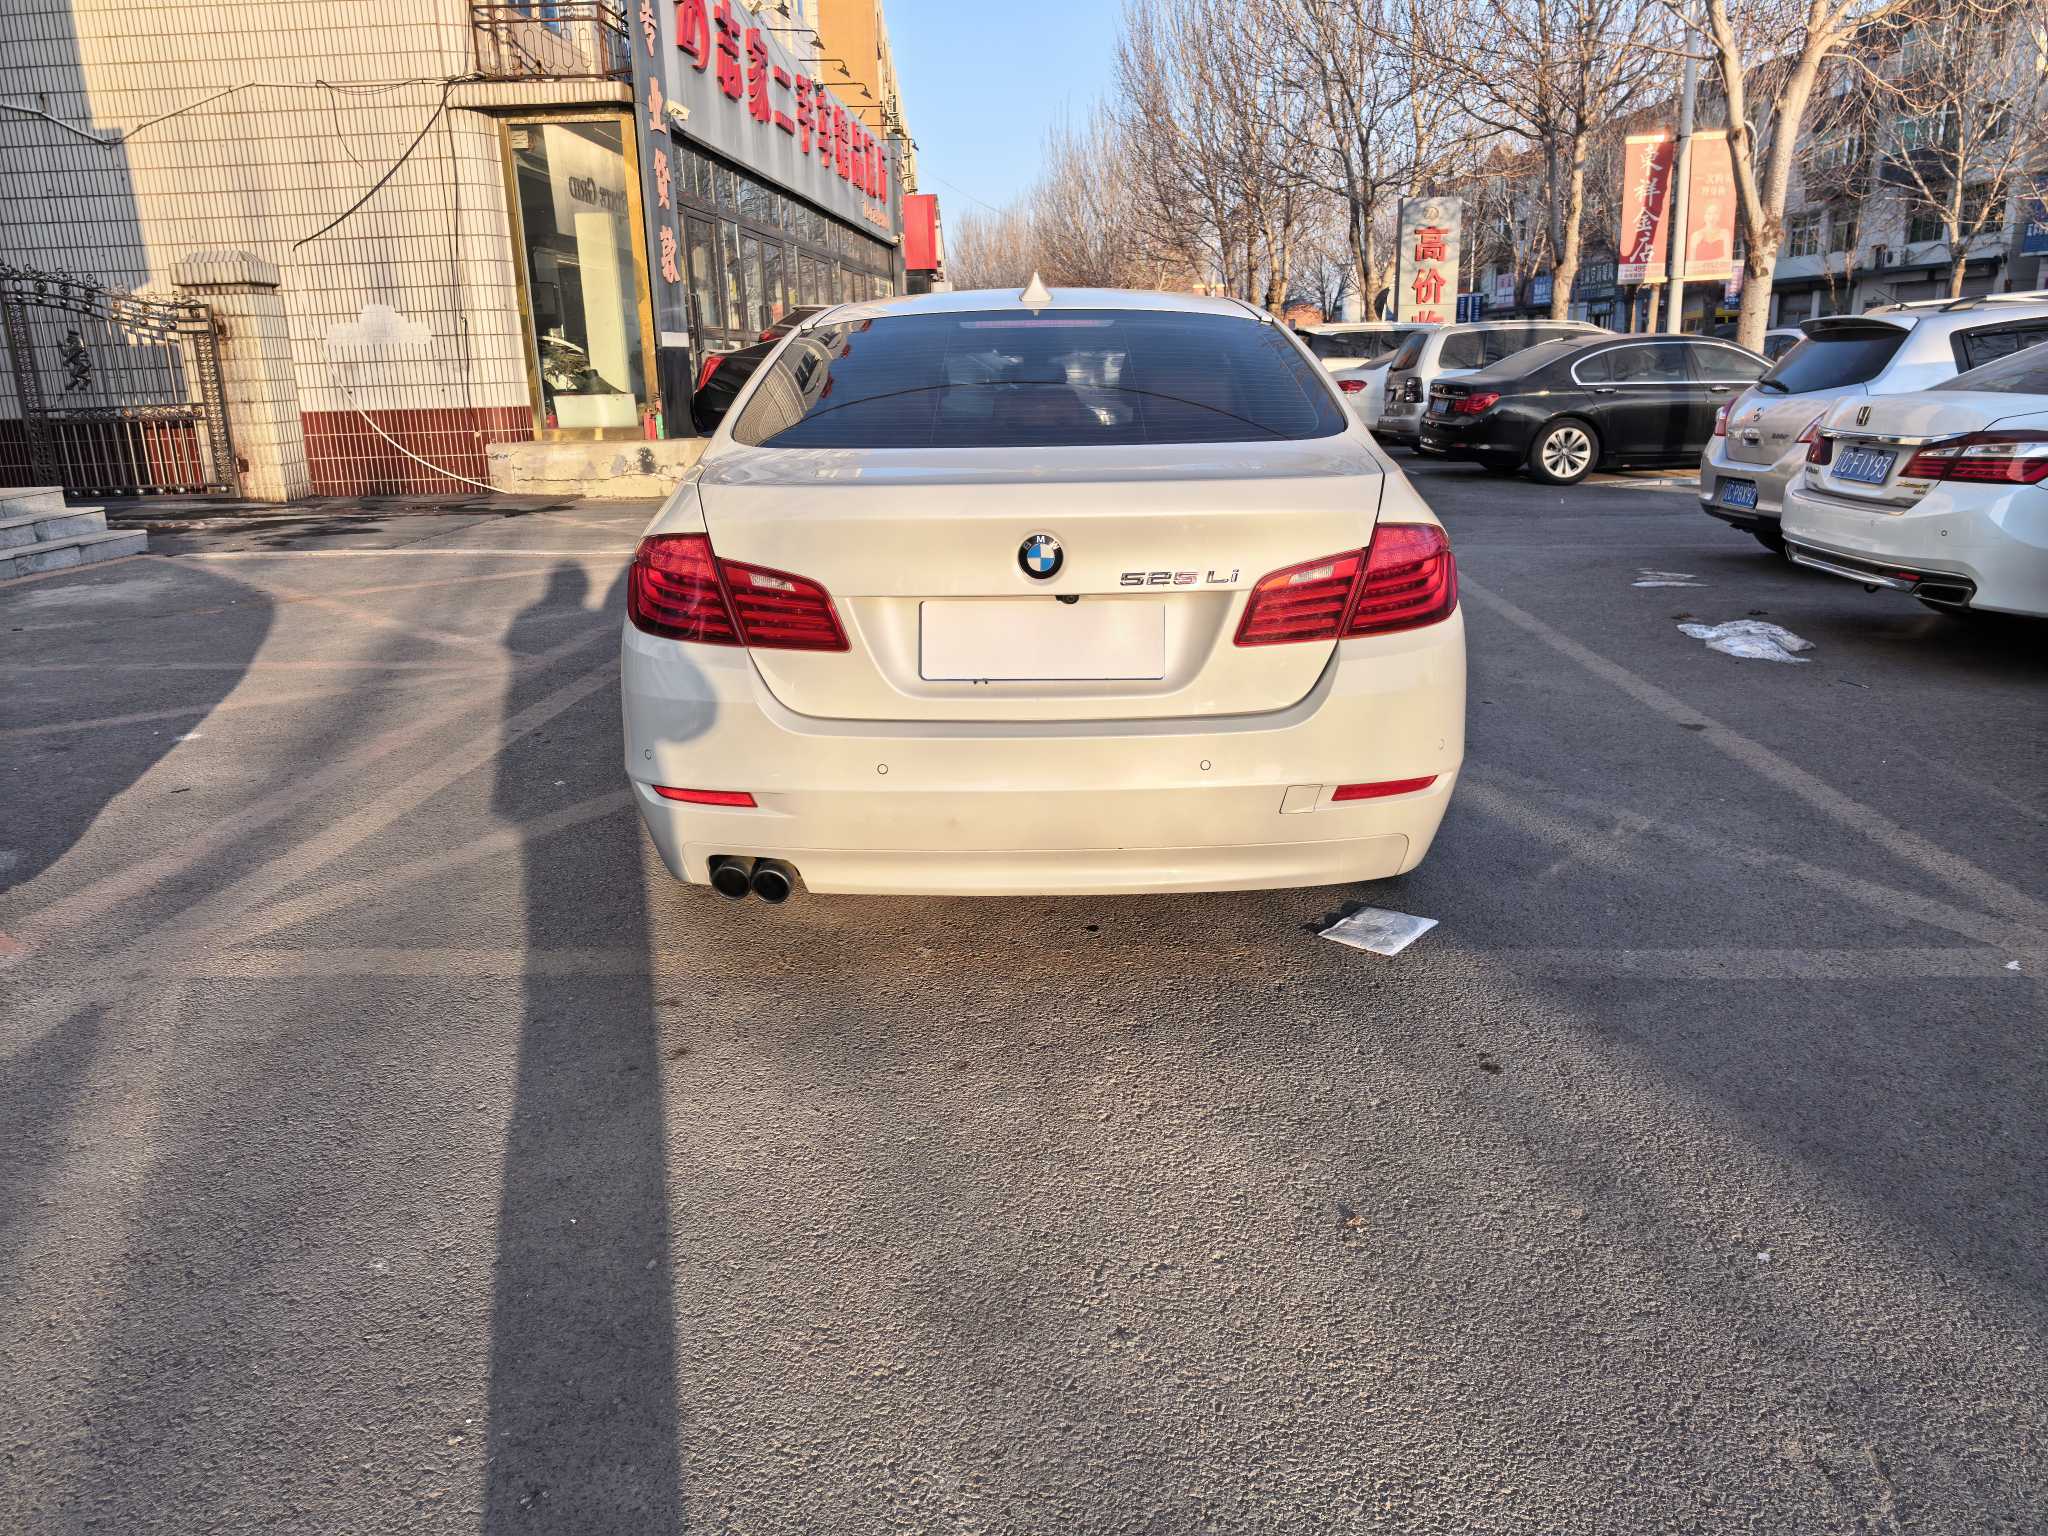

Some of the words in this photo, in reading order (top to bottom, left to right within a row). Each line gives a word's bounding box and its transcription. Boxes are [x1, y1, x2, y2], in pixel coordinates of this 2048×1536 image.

[1023, 534, 1062, 551] BMW
[1119, 571, 1200, 587] 525
[1205, 568, 1240, 585] Li
